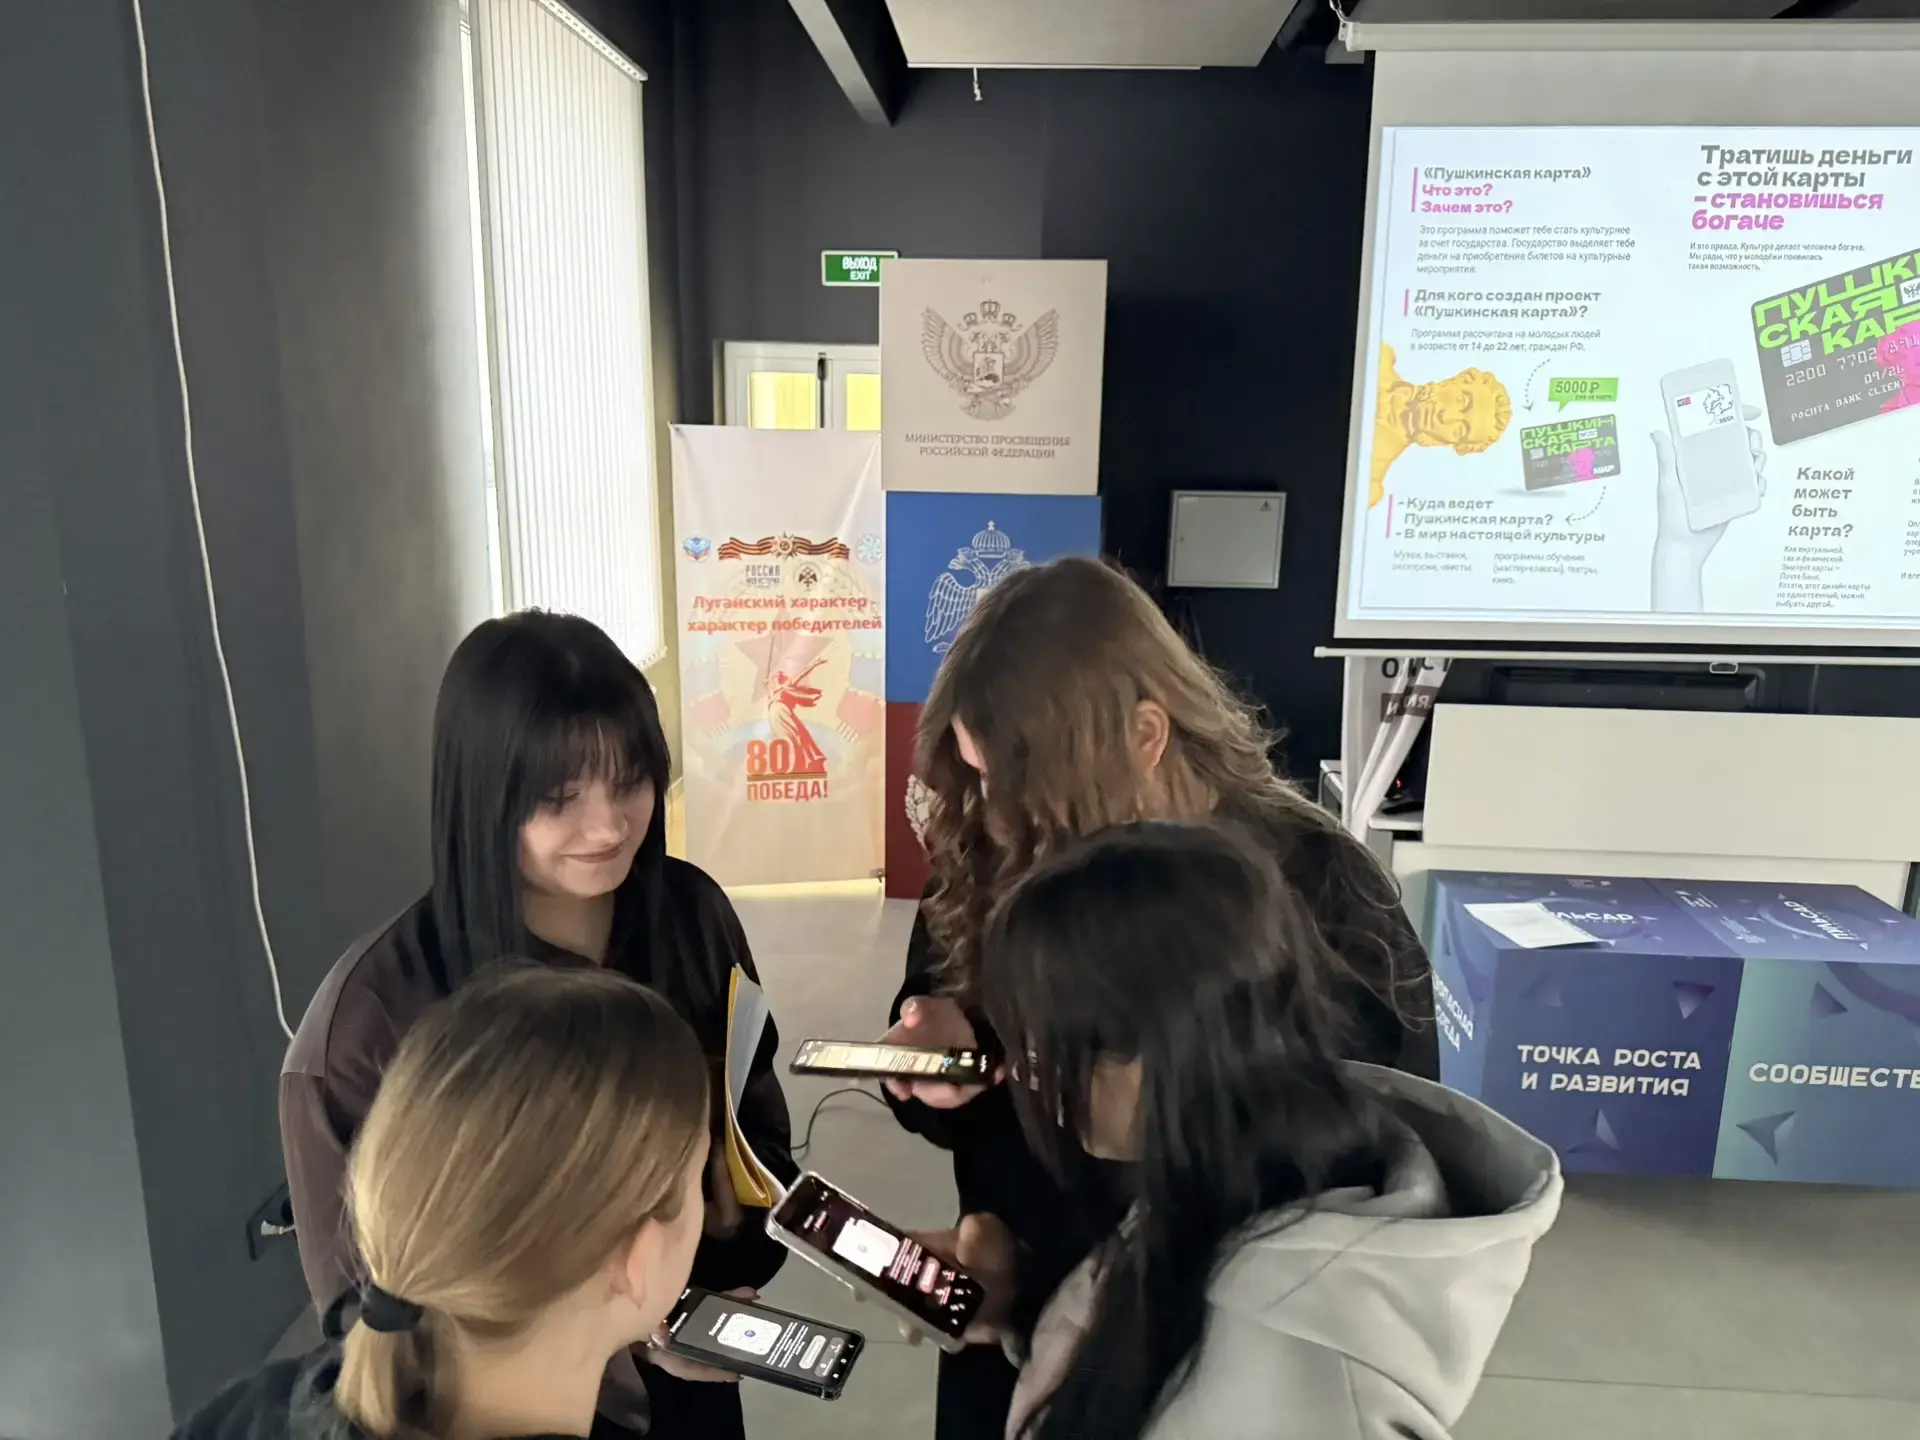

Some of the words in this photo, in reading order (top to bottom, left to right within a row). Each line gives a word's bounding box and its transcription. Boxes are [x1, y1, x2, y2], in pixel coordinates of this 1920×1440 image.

[1701, 144, 1814, 169] Тратишь
[1818, 149, 1913, 168] деньги
[1424, 167, 1531, 182] «Пушкинская
[1534, 166, 1592, 182] карта»
[1697, 171, 1712, 187] с
[1716, 166, 1778, 187] этой
[1782, 172, 1866, 192] карты
[1422, 184, 1452, 196] Что
[1454, 184, 1493, 196] это?
[1421, 200, 1472, 213] Зачем
[1474, 200, 1514, 213] это?
[1710, 192, 1884, 210] становишься
[1692, 209, 1785, 231] богаче
[1420, 224, 1436, 234] Это
[1437, 226, 1487, 237] программа
[1489, 226, 1530, 235] поможет
[1533, 224, 1552, 234] тебе
[1554, 226, 1578, 234] стать
[1580, 226, 1630, 236] культурнее
[1430, 240, 1450, 248] счет
[1452, 240, 1509, 249] государства.
[1512, 238, 1568, 249] Государство
[1570, 240, 1613, 248] выделяет
[1616, 238, 1636, 248] тебе
[1740, 242, 1774, 252] Культура
[1838, 242, 1865, 251] богаче.
[1416, 252, 1448, 262] деньги
[1450, 252, 1460, 260] на
[1462, 252, 1525, 262] приобретение
[1527, 251, 1564, 260] билетов
[1566, 252, 1577, 260] на
[1580, 252, 1631, 262] культурные
[1689, 252, 1701, 260] Мы
[842, 256, 878, 272] ВЫХОД
[850, 270, 872, 280] EXIT
[1414, 288, 1445, 303] Для
[1448, 292, 1483, 301] кого
[1486, 292, 1542, 303] создан
[1545, 292, 1601, 304] проект
[1414, 305, 1519, 320] «Пушкинская
[1521, 305, 1588, 320] карта»?
[1759, 286, 1898, 348] СКАЯ
[1412, 328, 1460, 339] Программа
[1463, 330, 1513, 340] рассчитана
[1528, 331, 1569, 339] молодых
[1571, 329, 1601, 339] людей
[1472, 342, 1482, 350] 14
[1483, 343, 1495, 352] до
[1496, 342, 1508, 350] 22
[1529, 343, 1568, 352] граждан
[1785, 364, 1826, 386] 2200
[1837, 348, 1878, 370] 7702
[1556, 380, 1588, 393] 5000
[905, 433, 989, 444] МИНИСТЕРСТВО
[990, 436, 1071, 447] ПРОСВЕЩЕНИЯ
[1522, 431, 1578, 449] СКАЯ
[1547, 436, 1616, 456] КАРТА
[919, 446, 989, 457] РОССИЙСКОЙ
[991, 448, 1056, 459] ФЕДЕРАЦИИ
[1796, 467, 1856, 480] Какой
[1794, 488, 1852, 500] может
[1407, 497, 1445, 512] Куда
[1448, 500, 1493, 510] ведет
[1792, 504, 1838, 518] быть
[1404, 513, 1496, 527] Пушкинская
[1500, 513, 1553, 528] карта?
[1404, 528, 1415, 539] В
[1419, 531, 1447, 542] мир
[1450, 529, 1532, 542] настоящей
[1534, 532, 1605, 544] культуры
[1788, 524, 1854, 540] карта?
[746, 565, 780, 576] РОССИЯ
[693, 596, 786, 610] Луганский
[790, 597, 868, 610] характер
[687, 620, 767, 634] характер
[772, 616, 882, 634] победителей
[747, 739, 790, 775] 80
[746, 780, 828, 801] ПОБЕДА!
[1517, 1044, 1600, 1065] ТОЧКА
[1614, 1049, 1701, 1070] РОСТА
[1521, 1072, 1538, 1090] И
[1550, 1074, 1690, 1096] РАЗВИТИЯ
